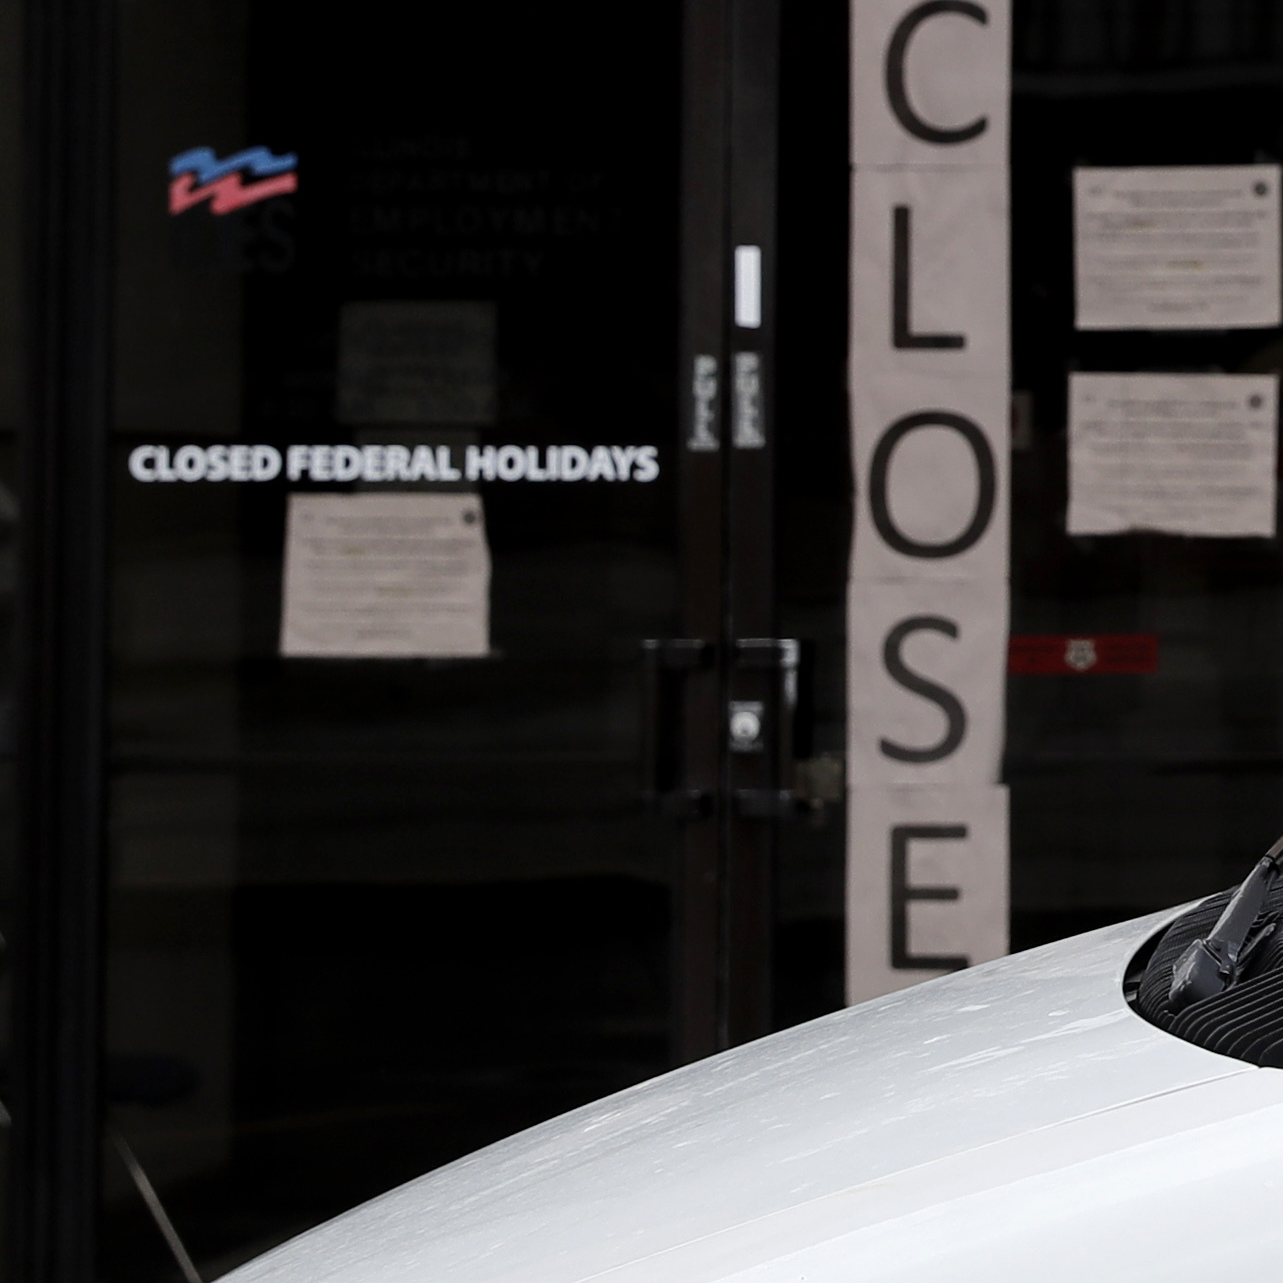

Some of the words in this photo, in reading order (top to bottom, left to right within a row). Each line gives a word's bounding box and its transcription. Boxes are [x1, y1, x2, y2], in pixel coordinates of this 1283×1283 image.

[349, 203, 623, 236] EMPLOYMENT
[352, 247, 544, 278] SECURITY
[128, 444, 282, 482] CLOSED
[286, 444, 462, 482] FEDERAL
[465, 444, 660, 482] HOLIDAYS
